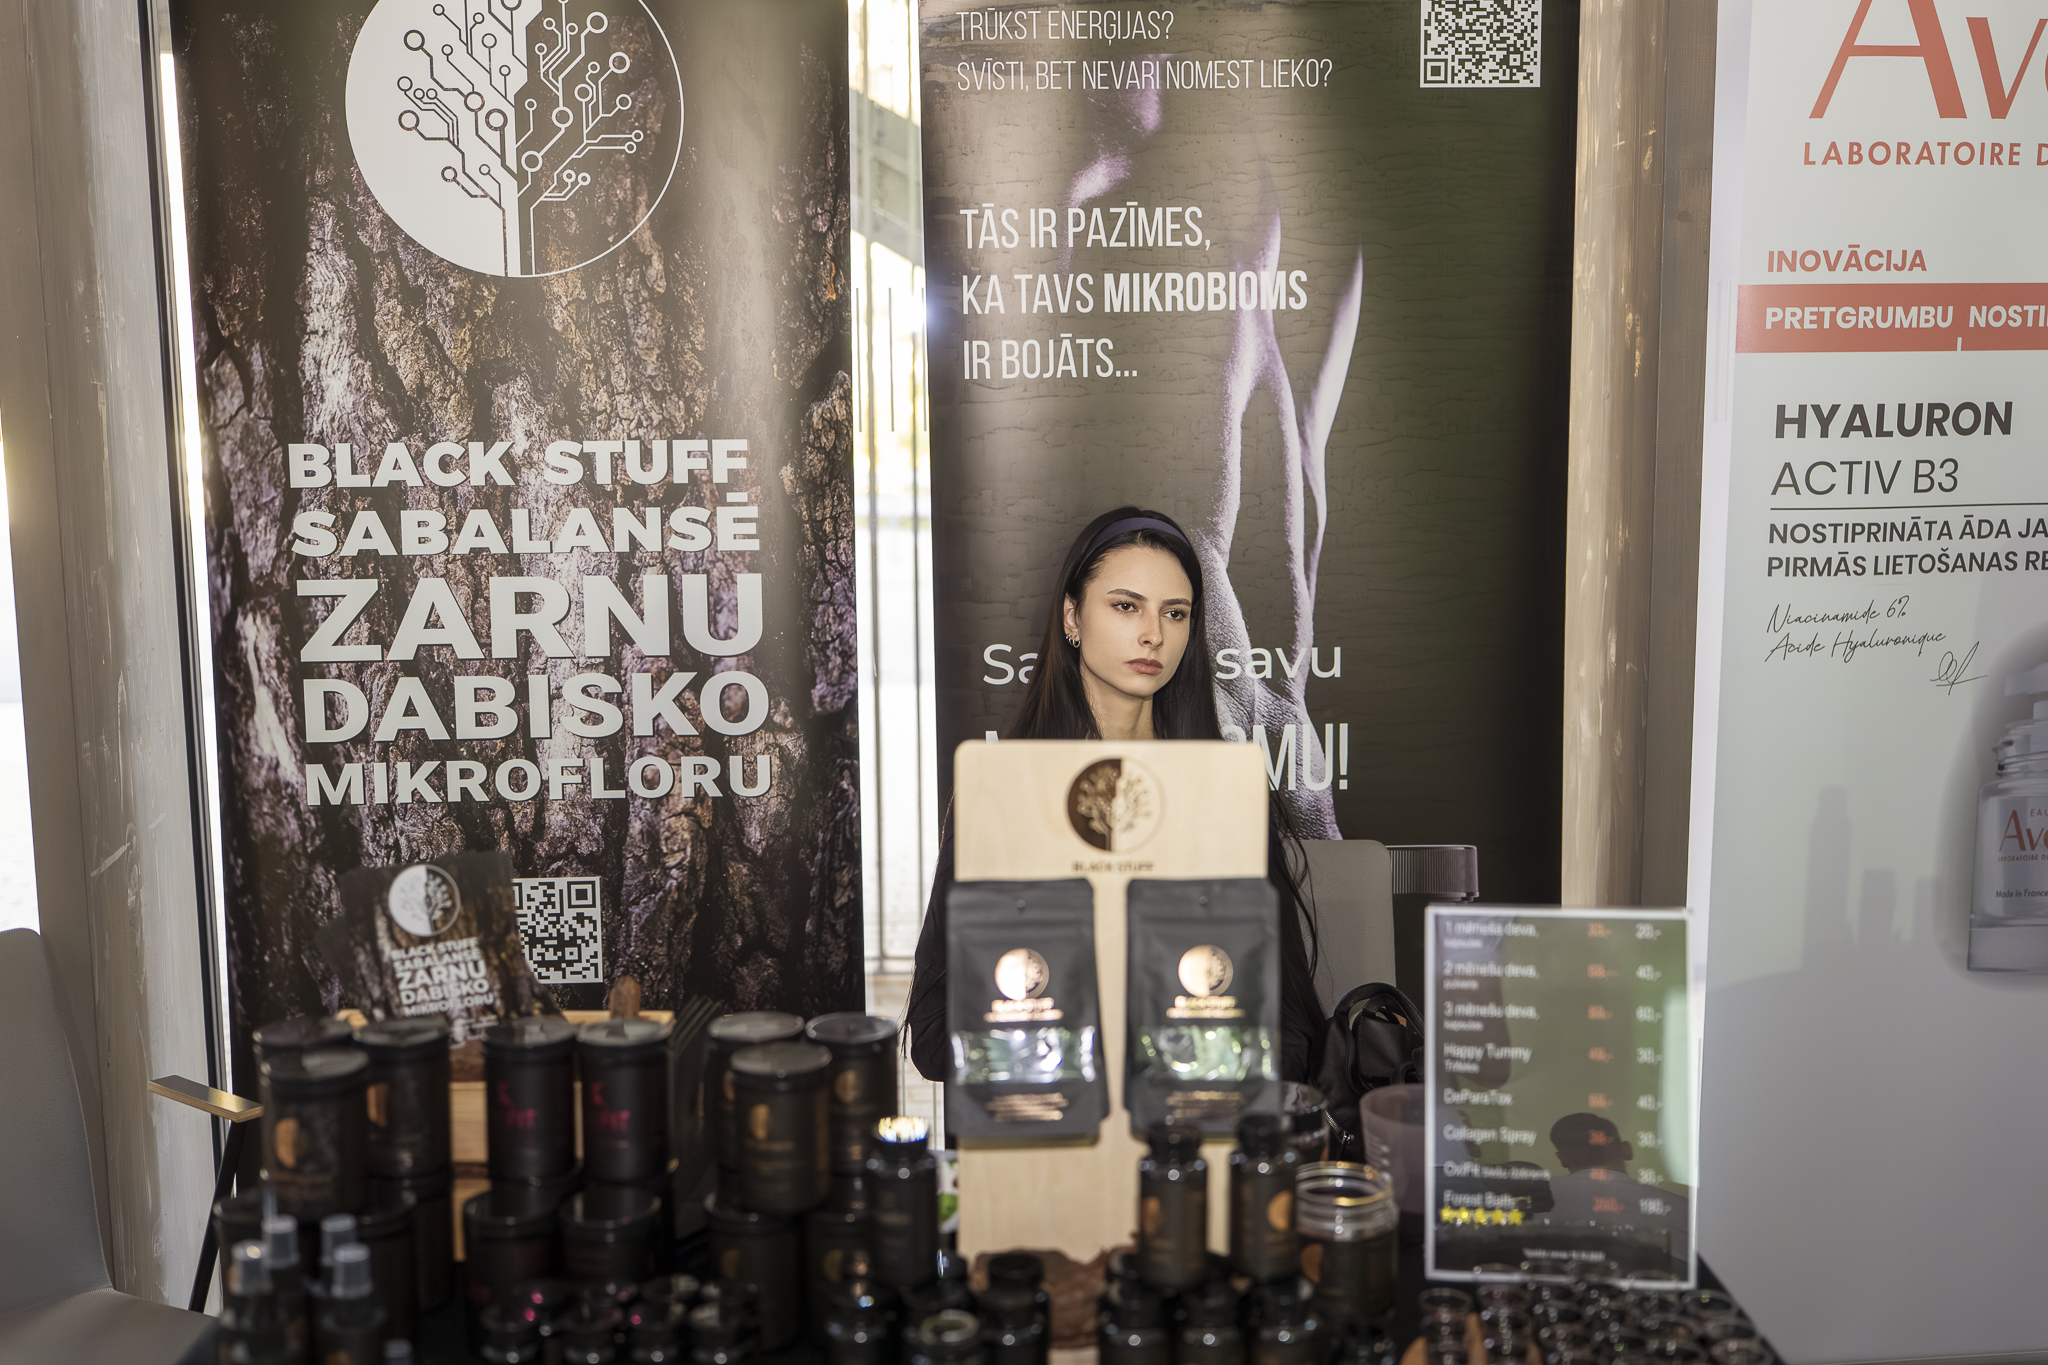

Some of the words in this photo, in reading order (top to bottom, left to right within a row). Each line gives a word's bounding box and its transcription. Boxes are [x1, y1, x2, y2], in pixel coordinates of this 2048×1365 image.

[956, 8, 1041, 41] TRŪKST
[1047, 10, 1174, 46] ENERĢIJAS?
[957, 58, 1029, 92] SVĪSTI,
[1036, 61, 1076, 90] BET
[1082, 60, 1160, 90] NEVARI
[1166, 59, 1254, 89] NOMEST
[1259, 58, 1333, 88] LIEKO?
[1809, 0, 2048, 120] Av
[1803, 141, 2022, 166] LABORATOIRE
[960, 203, 1020, 249] TĀS
[1029, 208, 1058, 248] IR
[1068, 201, 1211, 251] PAZĪMES,
[1767, 244, 1928, 273] INOVĀCIJA
[962, 275, 1005, 314] KA
[1014, 273, 1094, 314] TAVS
[1104, 270, 1308, 312] MIKROBIOMS
[1765, 306, 1953, 330] PRETGRUMBU
[1968, 305, 2048, 328] NOSTI
[963, 340, 991, 380] IR
[1001, 333, 1138, 379] BOJĀTS...
[1775, 401, 2013, 439] HYALURON
[288, 441, 516, 488] BLACK
[544, 439, 748, 486] STUFF
[1771, 460, 1902, 496] ACTIV
[1913, 458, 1959, 494] B3
[291, 492, 760, 557] SABALANSĒ
[1769, 516, 1953, 544] NOSTIPRINĀTA
[1959, 514, 2012, 540] ĀDA
[1767, 551, 1867, 577] PIRMĀS
[1873, 547, 2018, 576] LIETOŠANAS
[296, 573, 764, 662] ZARNU
[1766, 599, 1880, 633] Niacinamide
[1216, 646, 1341, 679] savu
[1765, 632, 1826, 662] Acide
[1831, 628, 1947, 663] Hyaluronique
[303, 670, 770, 743] DABISKO
[306, 754, 772, 806] MIKROFLORU
[1999, 810, 2048, 852] Av
[396, 960, 486, 990] ZARNU
[401, 979, 489, 1005] DABISKO
[1444, 1042, 1484, 1061] Happy
[1485, 1043, 1532, 1063] Tummy
